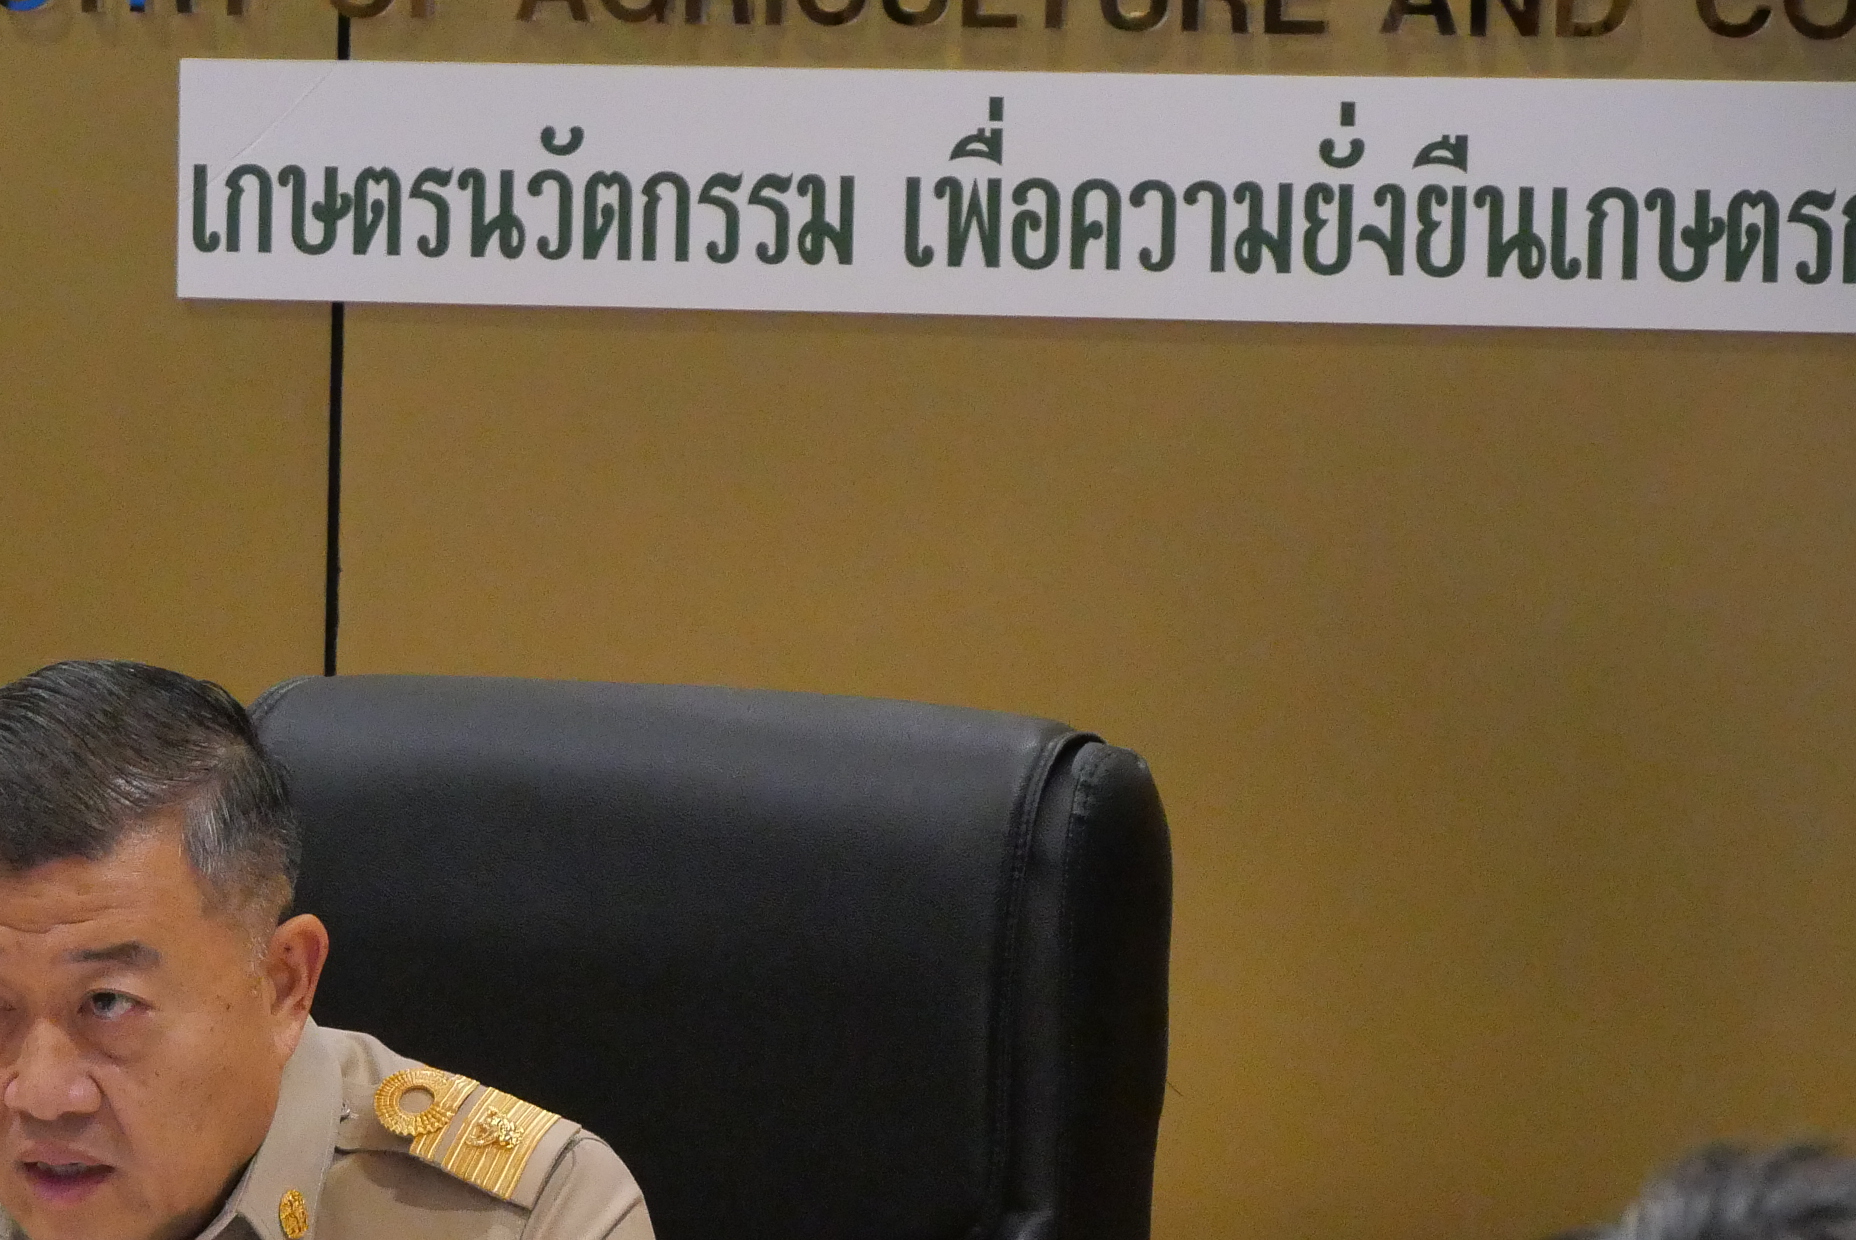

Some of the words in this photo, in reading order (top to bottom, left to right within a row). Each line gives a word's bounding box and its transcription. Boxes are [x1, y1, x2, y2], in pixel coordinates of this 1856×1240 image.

[191, 126, 855, 267] เกษตรนวัตกรรม
[904, 96, 1856, 286] เพื่อความยั่งยืนเกษตร
